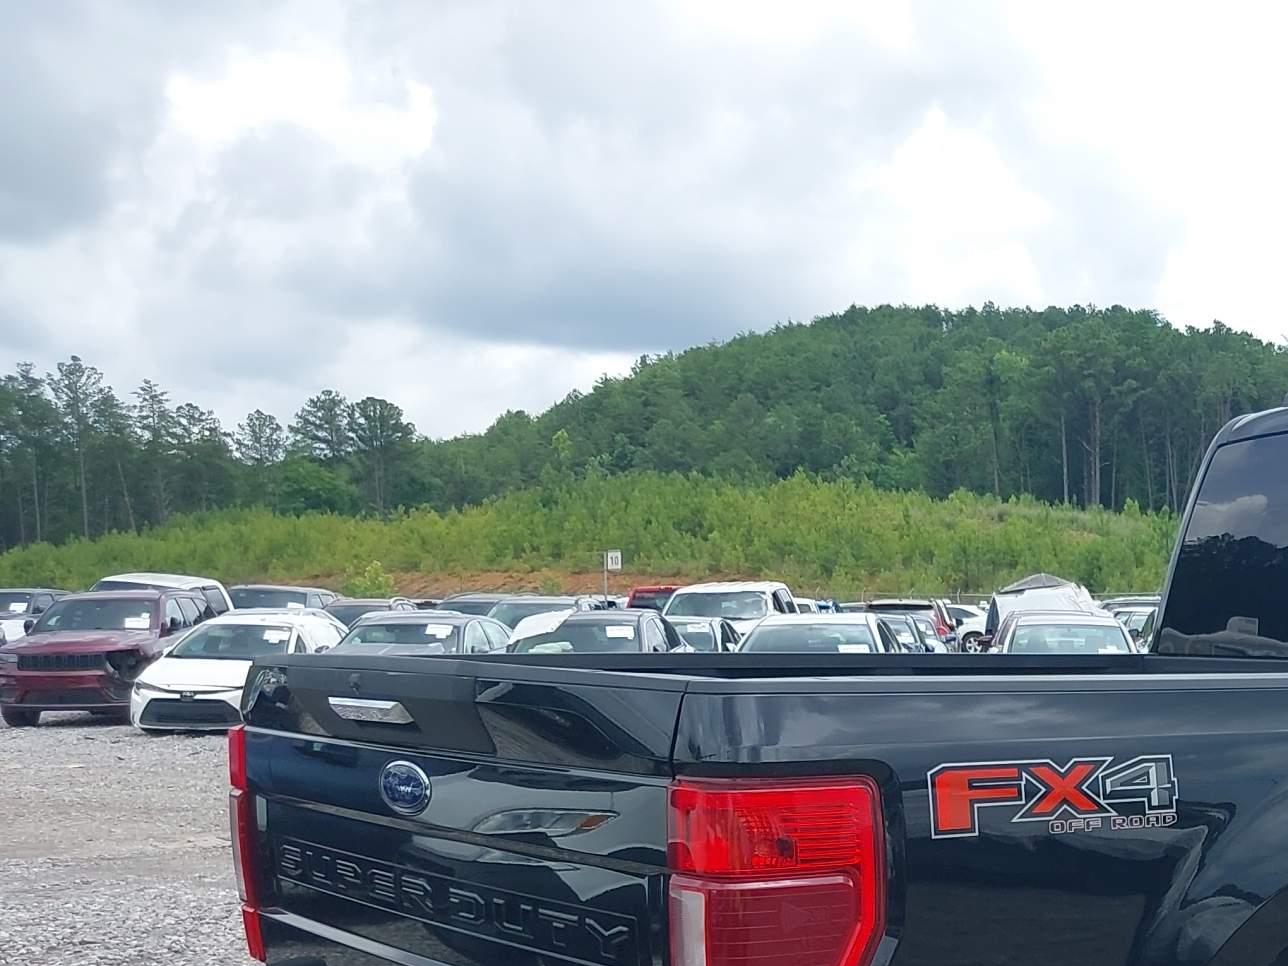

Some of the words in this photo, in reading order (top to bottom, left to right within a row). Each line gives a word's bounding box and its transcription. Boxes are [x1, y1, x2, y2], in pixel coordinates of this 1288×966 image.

[610, 555, 619, 566] 10
[927, 754, 1179, 840] FX4
[1049, 817, 1102, 834] OFF
[1110, 812, 1179, 831] ROAD
[280, 844, 433, 913] SUPER
[449, 887, 630, 959] DUTY
